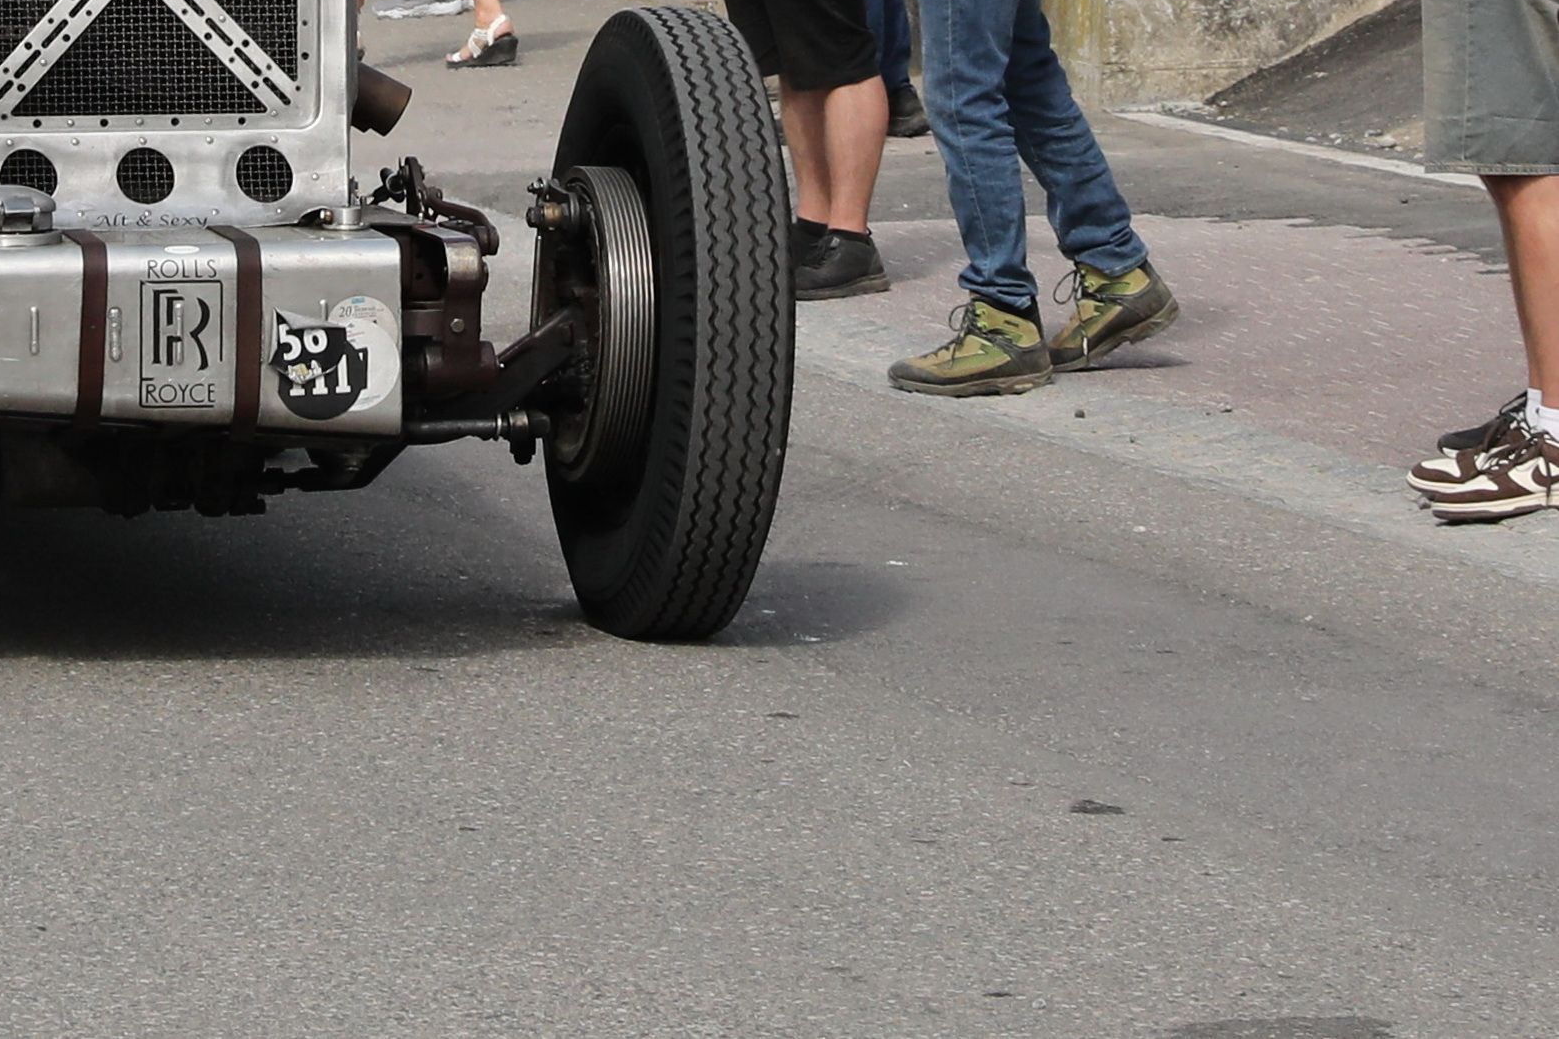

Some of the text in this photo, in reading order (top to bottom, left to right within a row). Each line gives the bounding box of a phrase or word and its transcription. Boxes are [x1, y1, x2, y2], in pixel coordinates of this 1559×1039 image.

[92, 212, 209, 229] Alt & Sexy
[147, 259, 217, 279] ROLLS
[145, 383, 216, 404] ROYCE
